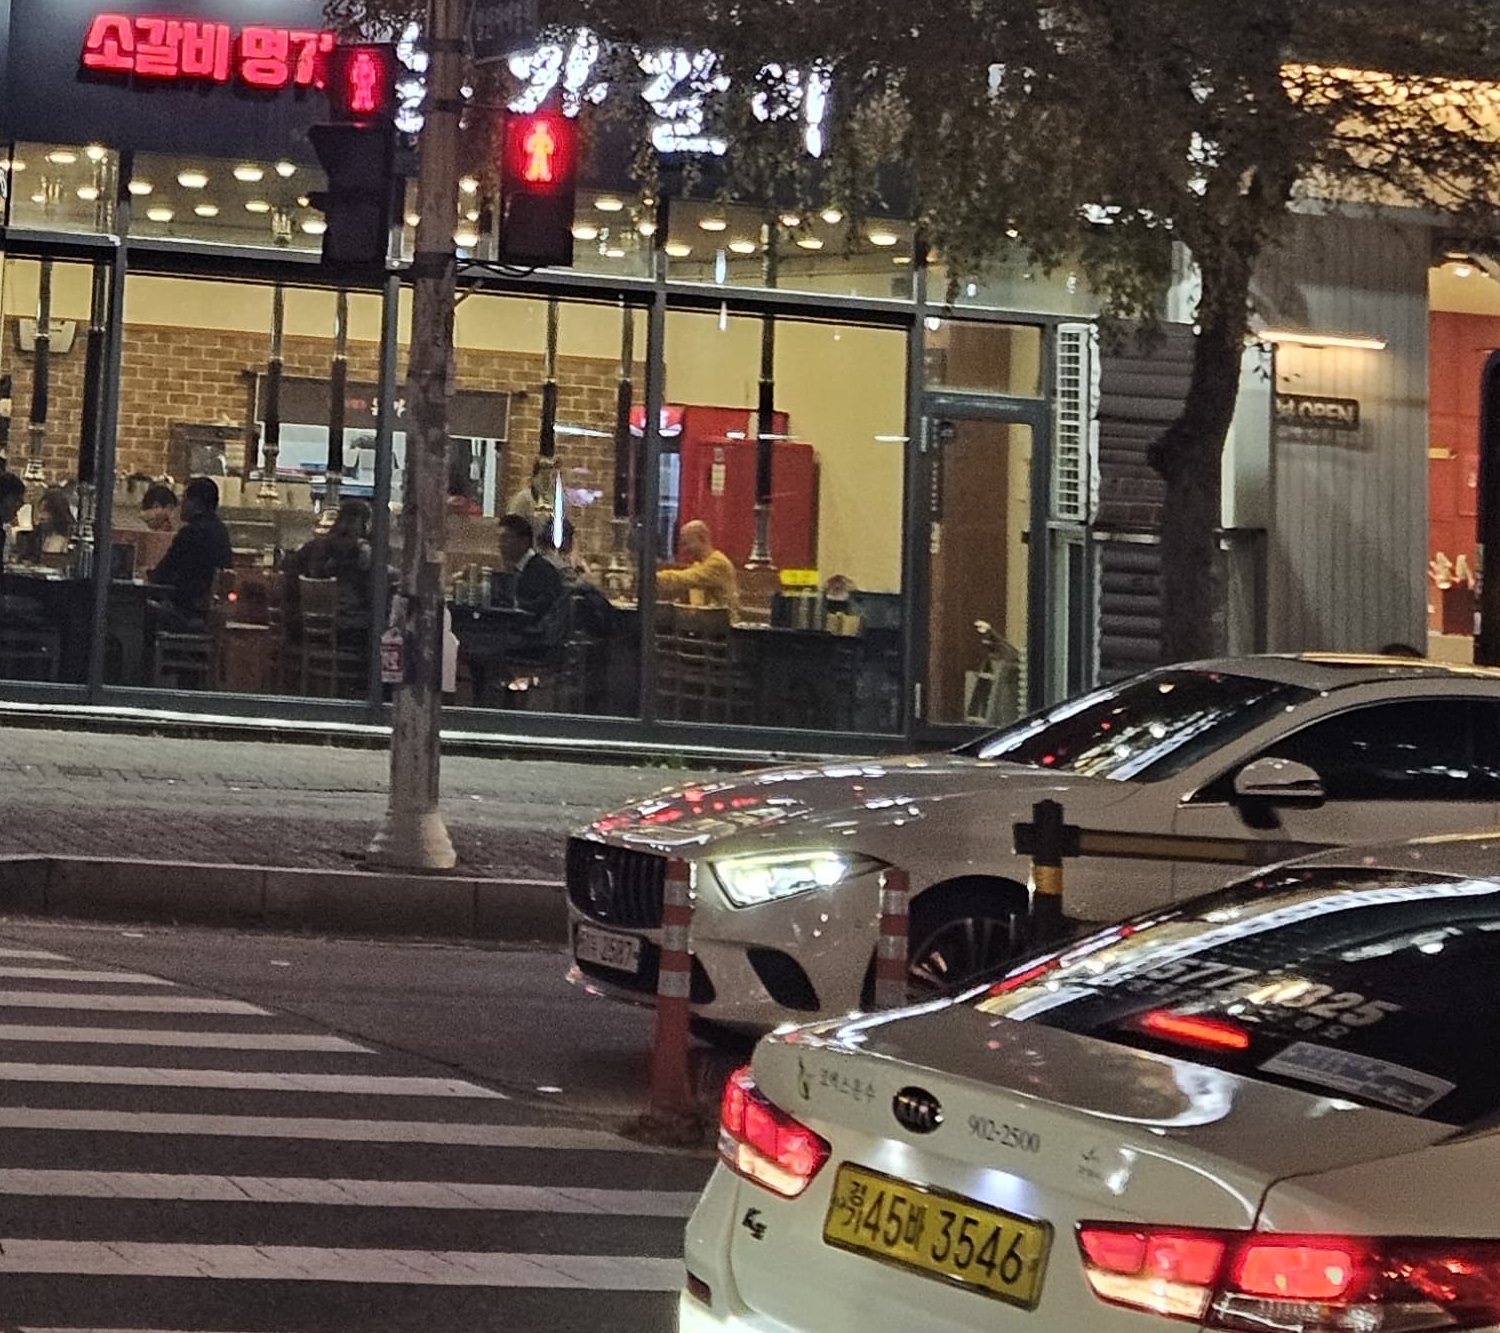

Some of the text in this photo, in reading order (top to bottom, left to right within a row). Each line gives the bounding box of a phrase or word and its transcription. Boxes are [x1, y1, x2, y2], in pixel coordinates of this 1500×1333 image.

[81, 13, 230, 83] 소갈비
[1298, 401, 1355, 423] OPEN
[968, 1115, 1041, 1154] 902-2500
[862, 1184, 930, 1255] 45바
[930, 1209, 1025, 1289] 3546
